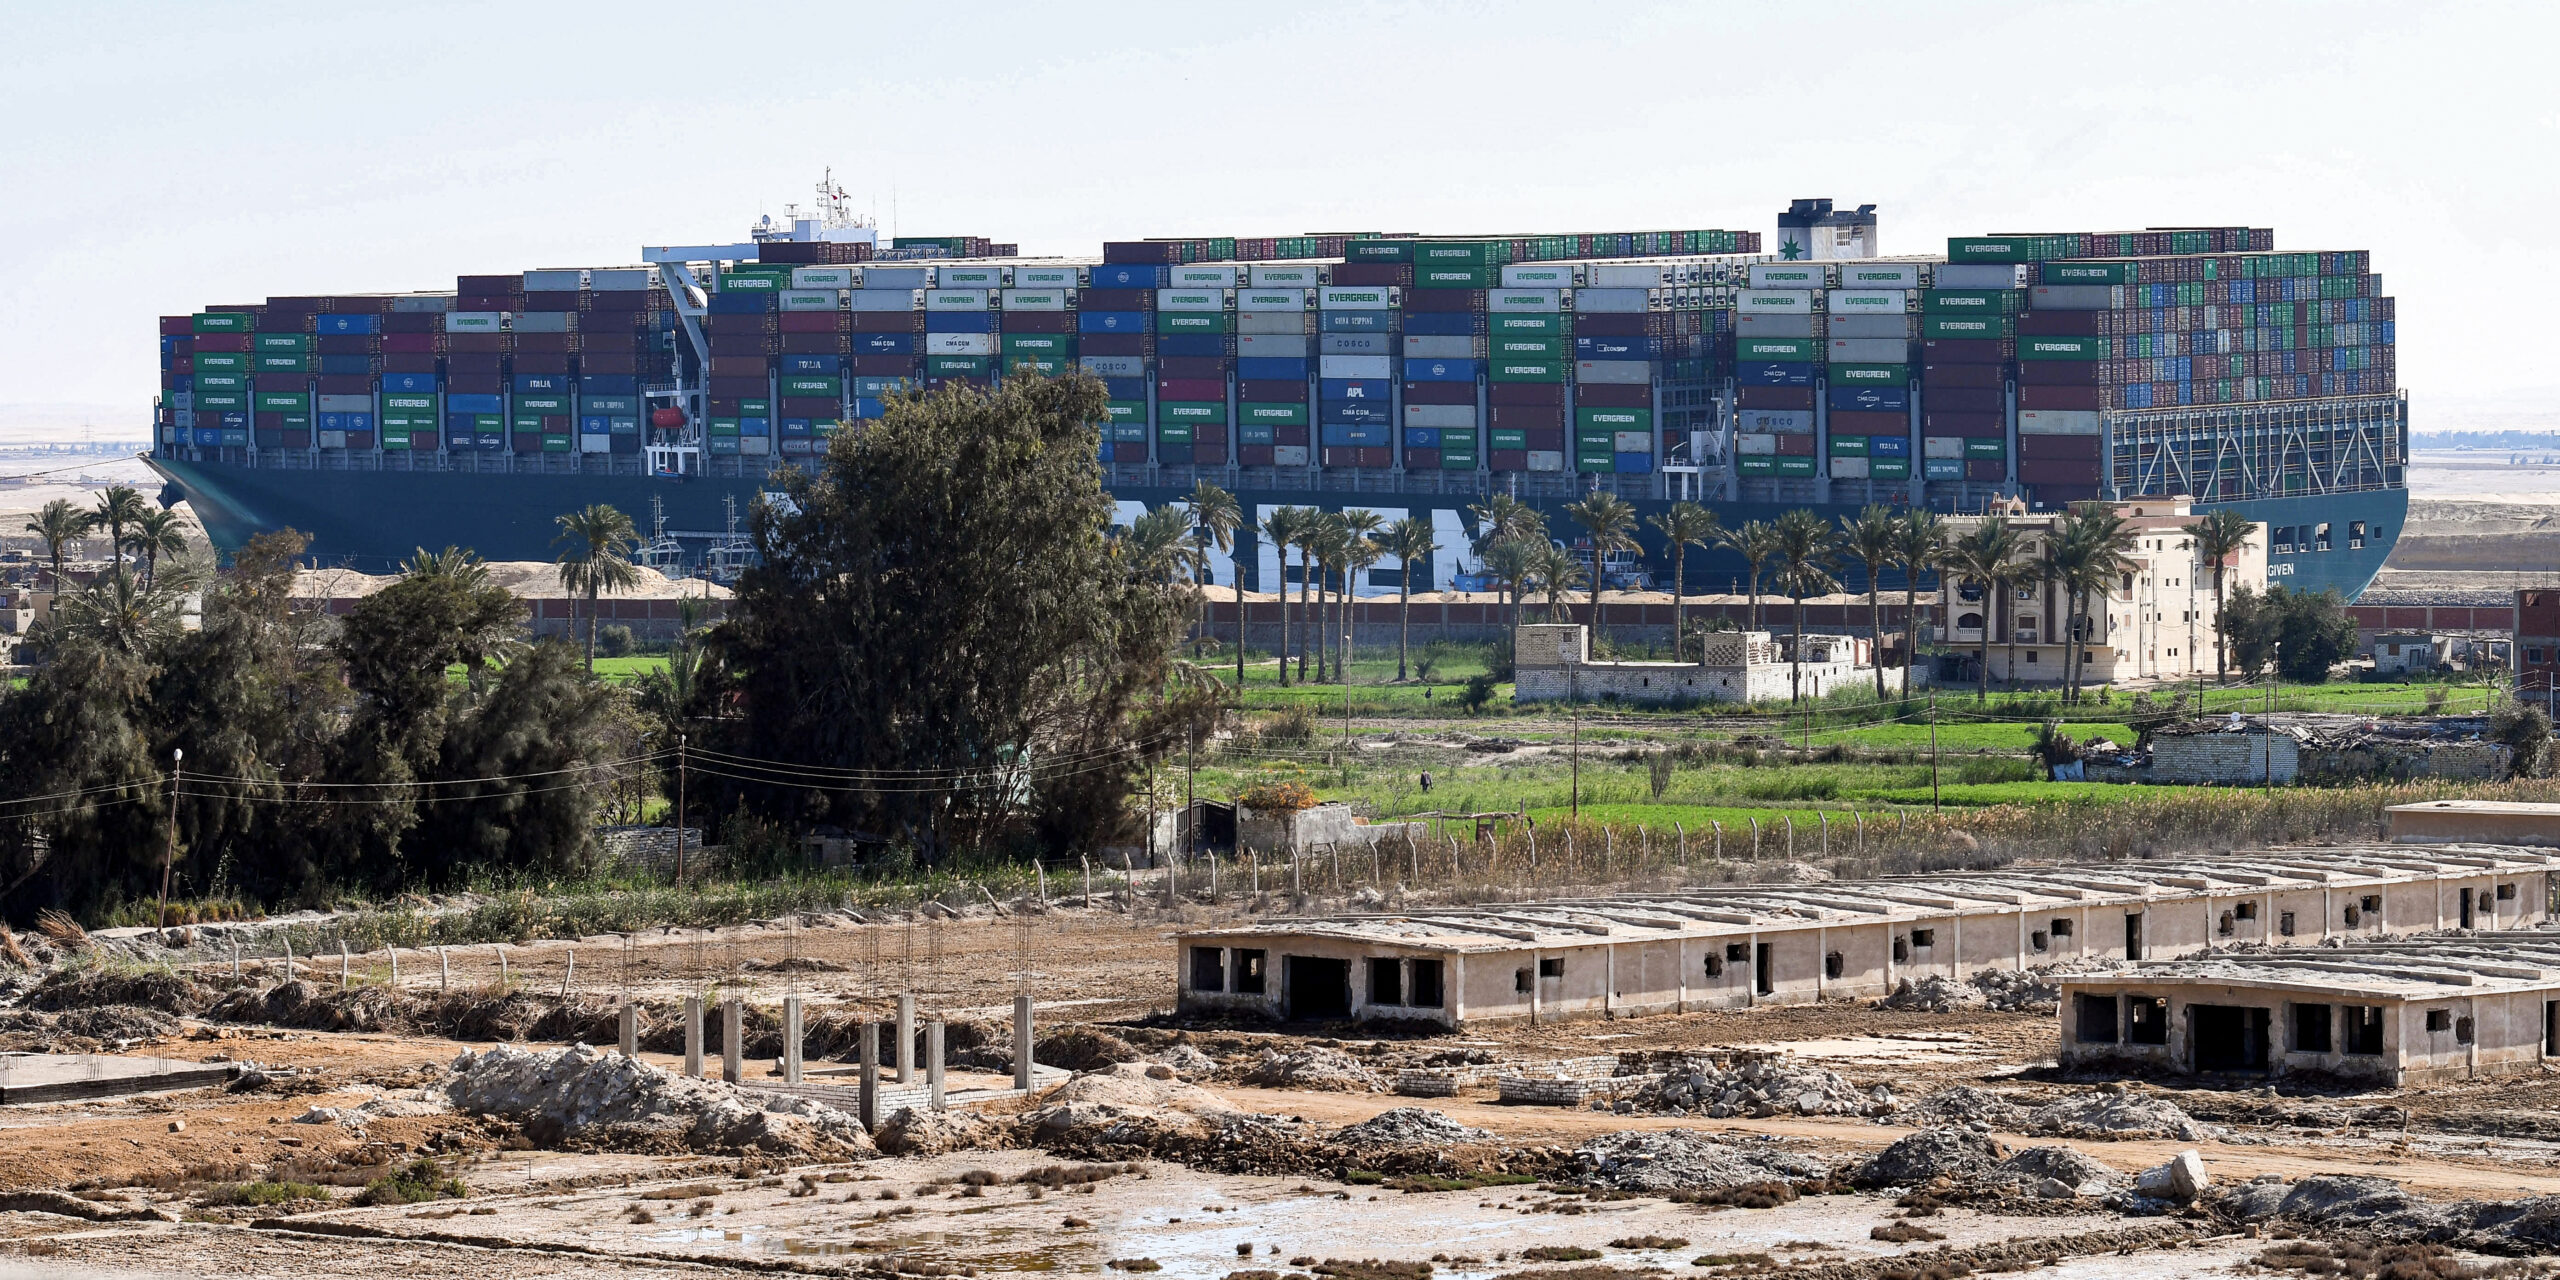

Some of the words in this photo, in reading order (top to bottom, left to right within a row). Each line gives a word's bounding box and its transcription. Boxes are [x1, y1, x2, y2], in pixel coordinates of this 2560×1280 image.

[2061, 269, 2107, 277] EVERGREEN
[728, 280, 772, 288] EVERGREEN
[1329, 293, 1379, 302] EVERGREEN
[1940, 322, 1986, 330] EVERGREEN
[1753, 345, 1796, 353] EVERGREEN
[1505, 366, 1546, 374] EVERGREEN
[530, 380, 551, 388] ITALIA
[1347, 388, 1364, 397] APL
[389, 399, 429, 407] EVERGREEN
[1254, 409, 1293, 417] EVERGREEN
[2268, 563, 2294, 576] GIVEN
